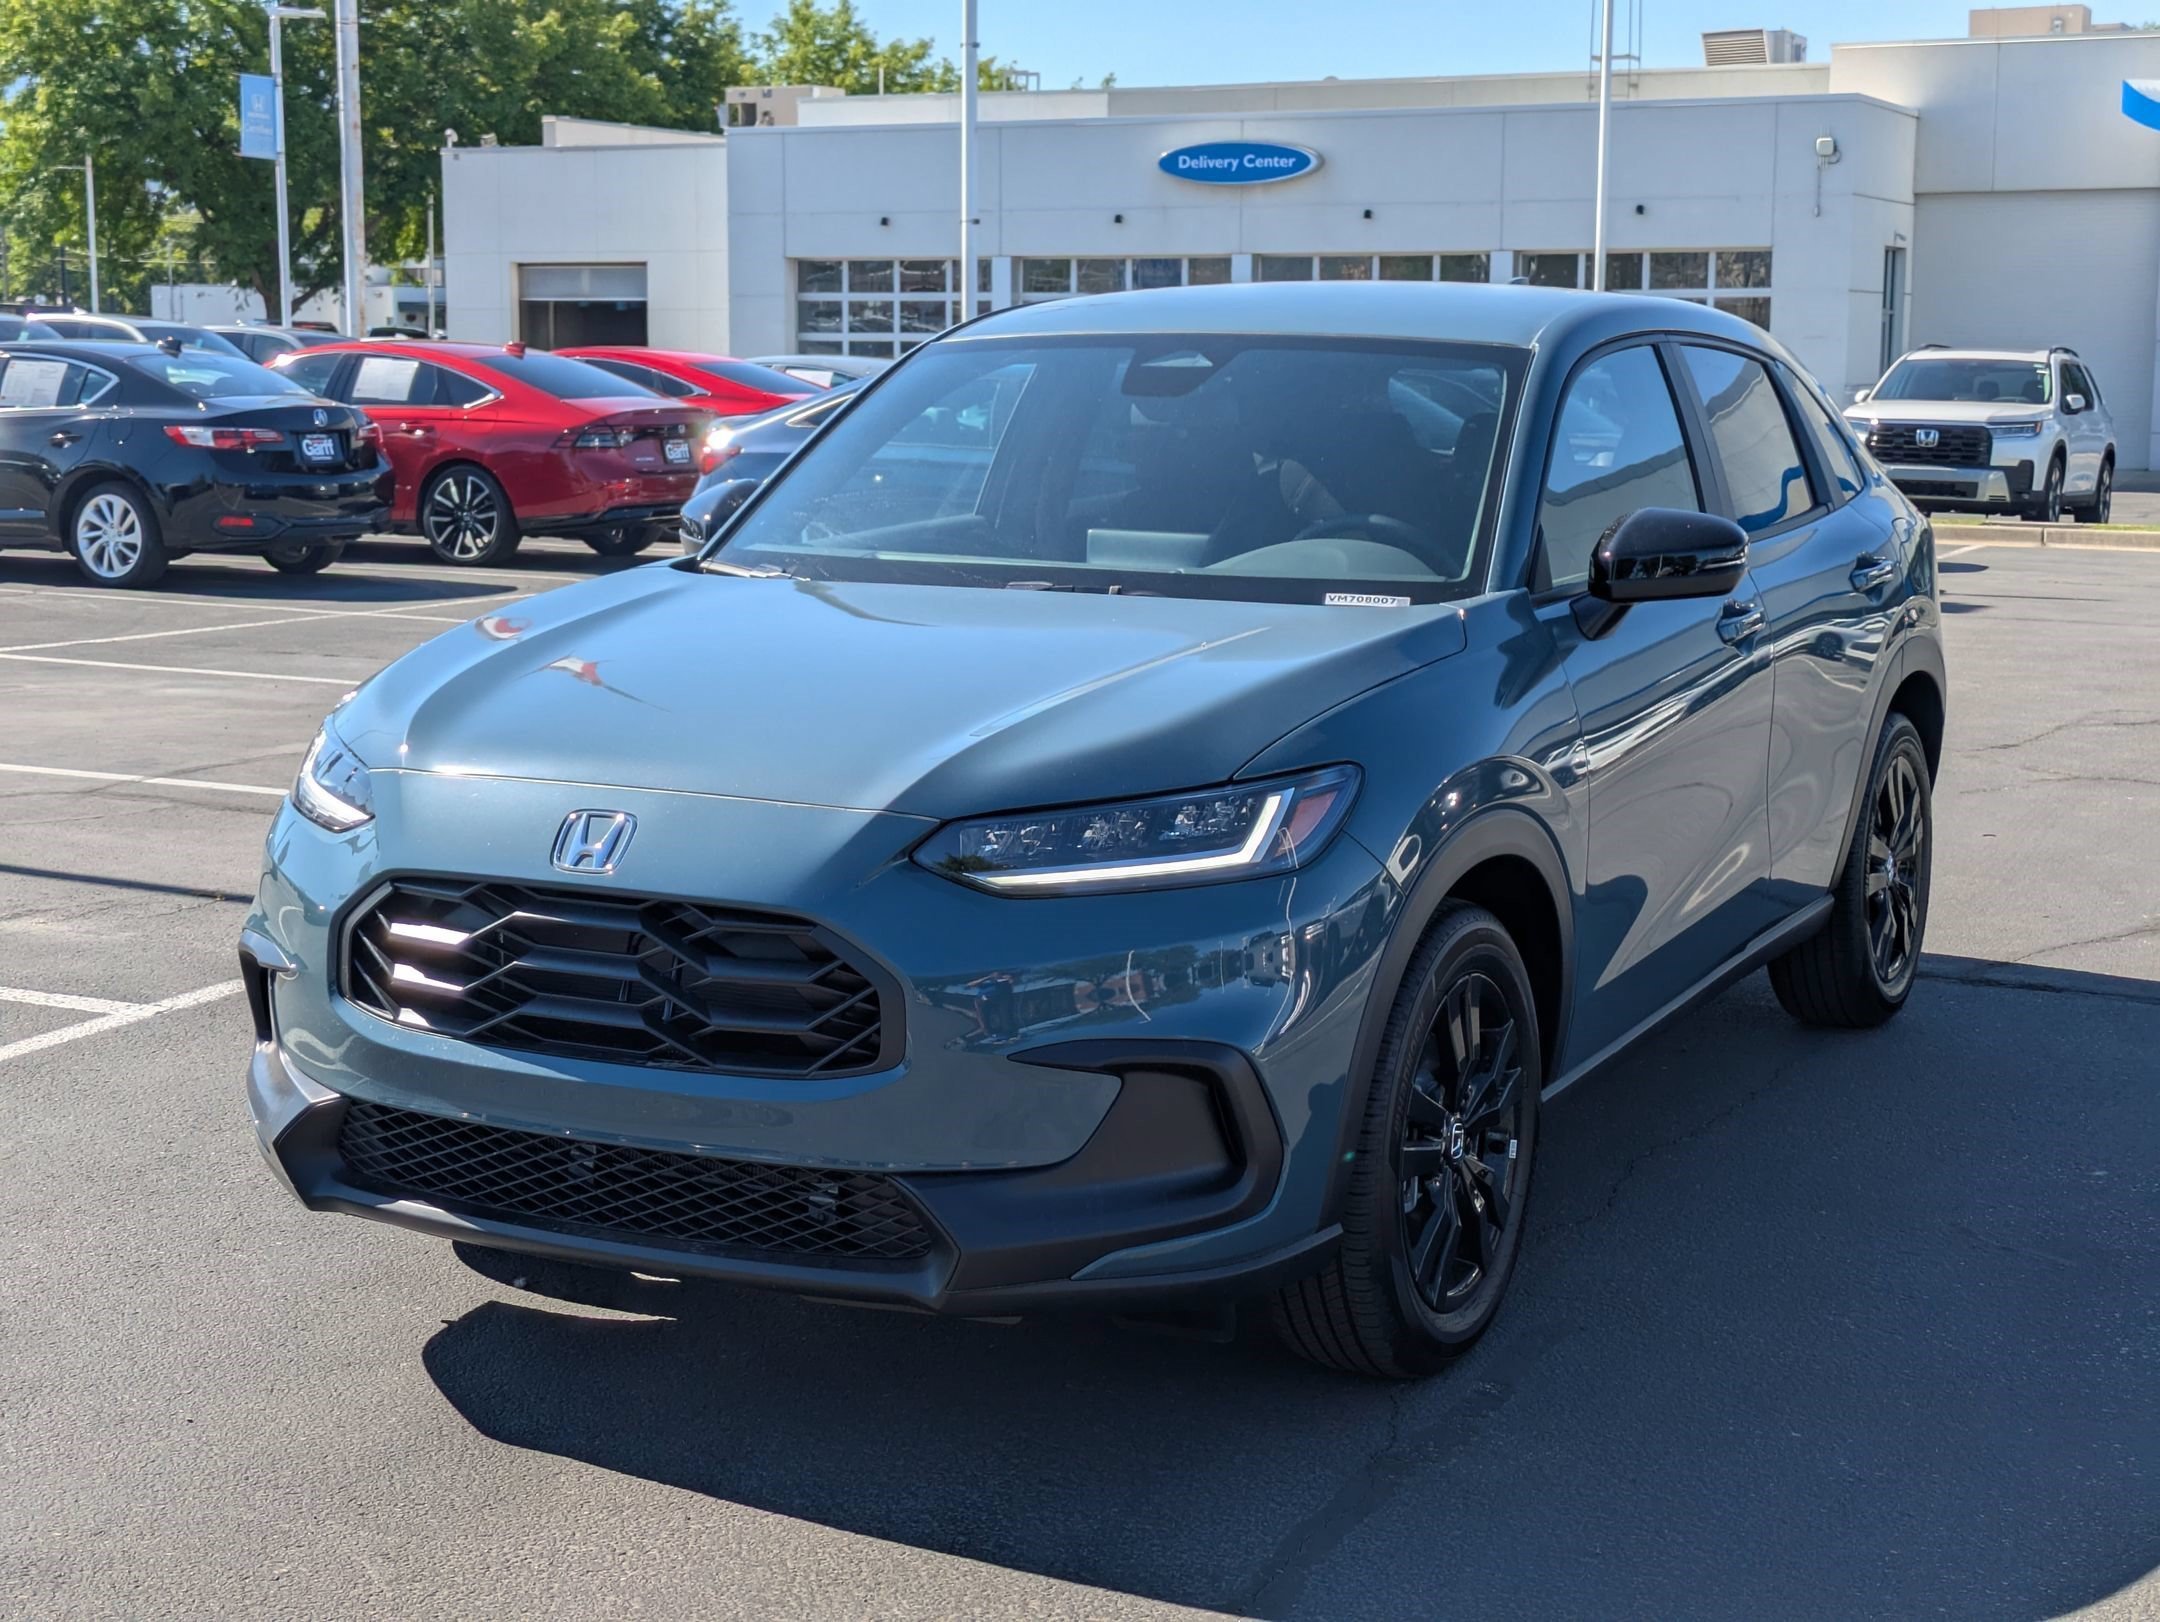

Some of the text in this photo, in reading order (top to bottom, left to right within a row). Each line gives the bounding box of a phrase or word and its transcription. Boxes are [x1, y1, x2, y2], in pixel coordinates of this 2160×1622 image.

[1178, 154, 1297, 172] Delivery Center
[1328, 595, 1397, 605] VM708007
